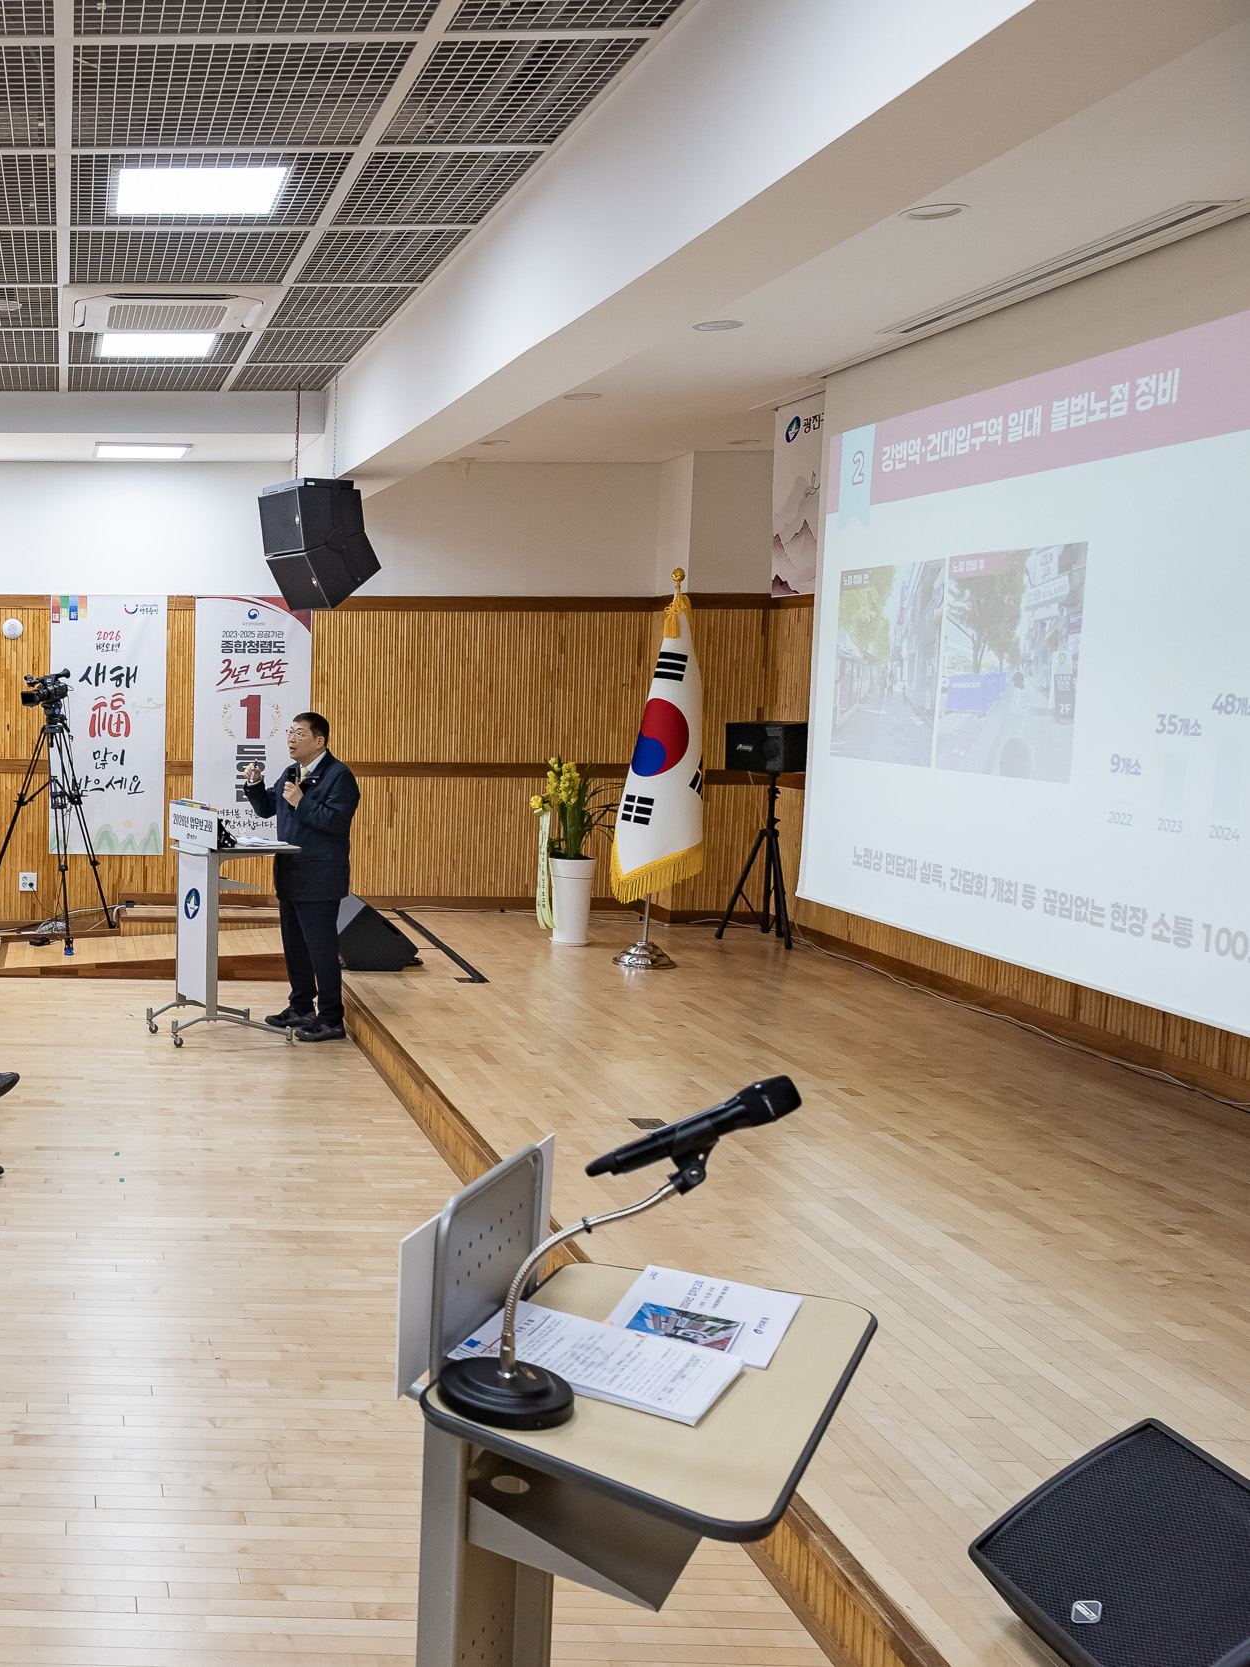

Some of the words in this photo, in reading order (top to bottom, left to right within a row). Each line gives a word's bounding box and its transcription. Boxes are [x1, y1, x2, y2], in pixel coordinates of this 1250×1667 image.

[852, 450, 865, 486] 2
[1008, 405, 1042, 443] 일대
[1050, 382, 1130, 433] 불법노점
[1134, 368, 1180, 412] 정비
[952, 561, 965, 572] 노점
[96, 630, 121, 641] 2026
[96, 642, 120, 653] 병오년
[221, 640, 285, 654] 종합청렴도
[79, 662, 138, 688] 새해
[216, 658, 250, 686] 3년
[256, 659, 288, 686] 연속
[89, 692, 130, 738] 福
[240, 695, 261, 739] 1
[1059, 703, 1072, 714] 2F
[1155, 714, 1202, 736] 35개소
[93, 748, 125, 770] 많이
[1110, 753, 1141, 775] 9개소
[74, 775, 144, 797] 받으세요
[190, 817, 213, 832] 업무보고회
[1108, 811, 1132, 826] 2022
[1157, 818, 1182, 833] 2023
[1208, 825, 1240, 842] 2024
[852, 846, 883, 872] 노점상
[885, 852, 917, 881] 면담과
[920, 861, 947, 892] 설득,
[949, 867, 987, 898] 간담회
[990, 877, 1018, 906] 개최
[1021, 884, 1036, 911] 등
[1043, 888, 1106, 928] 끊임없는
[1110, 902, 1148, 938] 현장
[1151, 912, 1194, 949] 소통
[1202, 922, 1250, 964] 100
